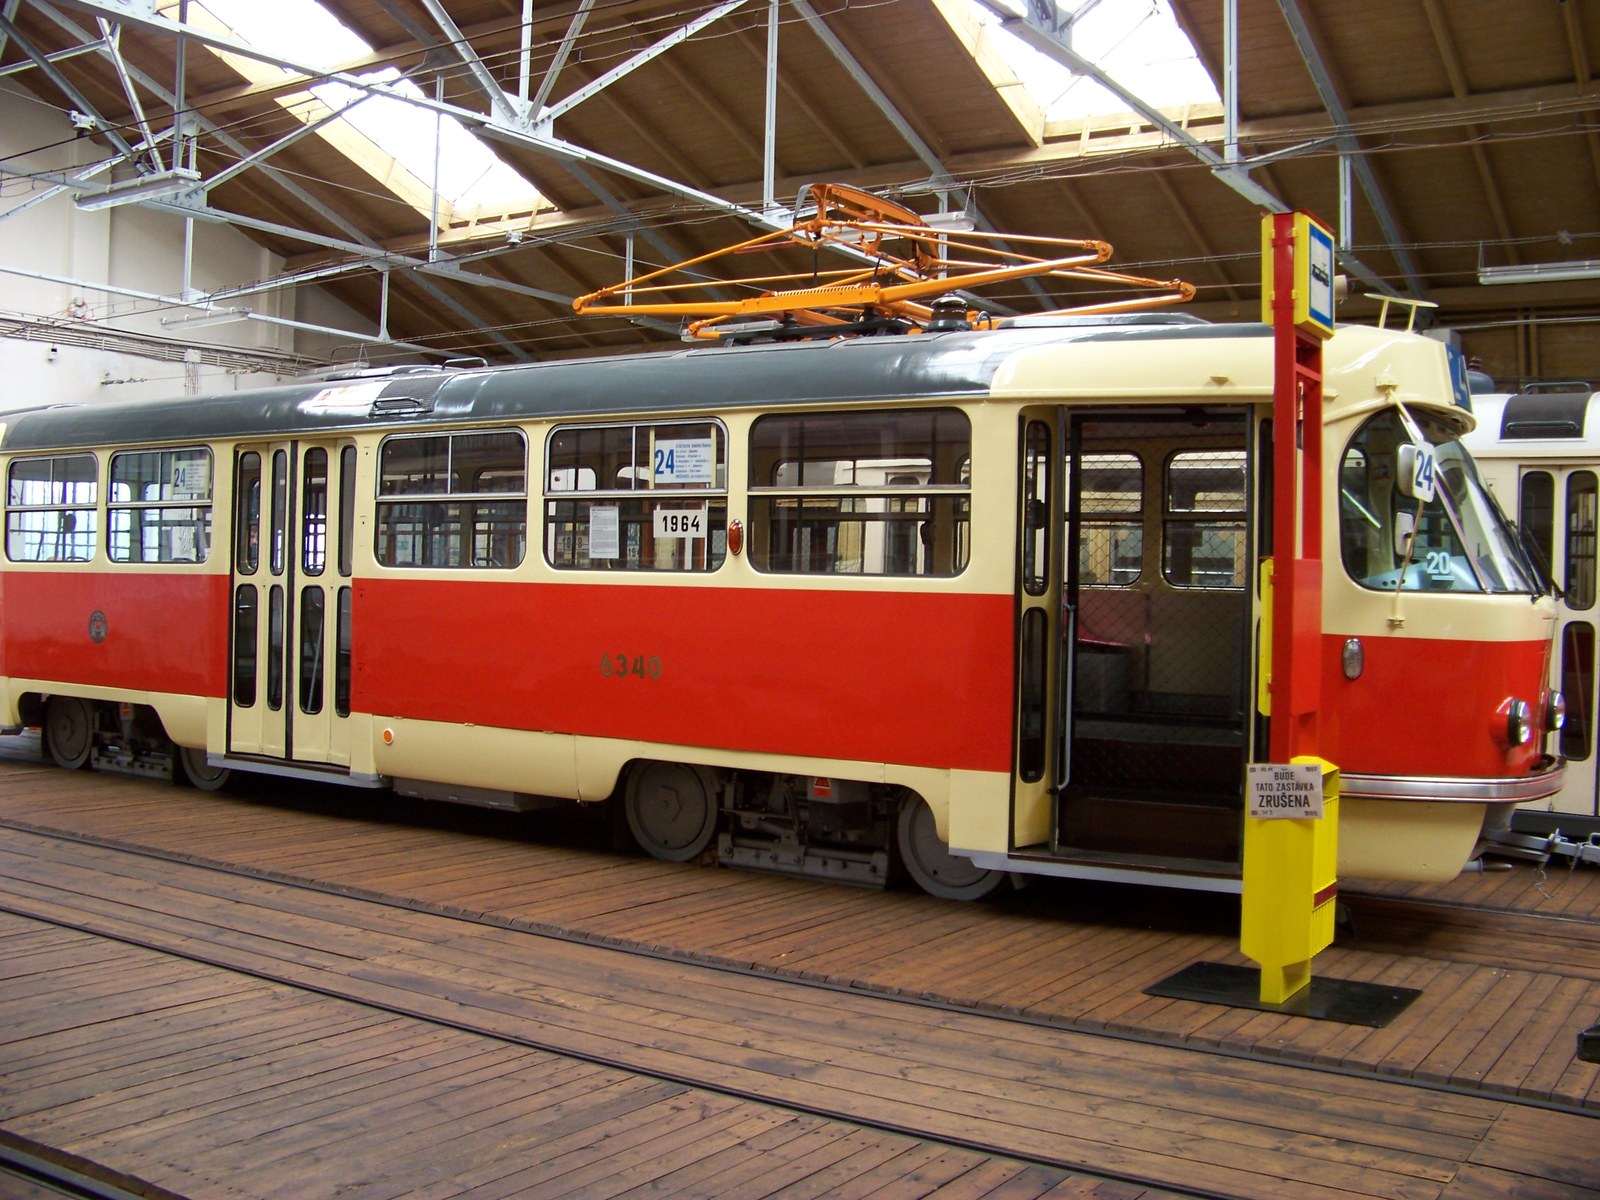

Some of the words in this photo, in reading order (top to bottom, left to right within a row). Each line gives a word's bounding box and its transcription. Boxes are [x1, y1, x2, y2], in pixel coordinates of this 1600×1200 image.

[655, 449, 675, 475] 24
[1415, 450, 1433, 491] 24
[174, 467, 186, 488] 24
[662, 514, 700, 533] 1964
[1426, 551, 1450, 574] 20
[601, 652, 663, 680] 6340
[1274, 771, 1295, 781] BUDE
[1255, 782, 1274, 792] TATO
[1258, 792, 1311, 808] ZRUŠENA
